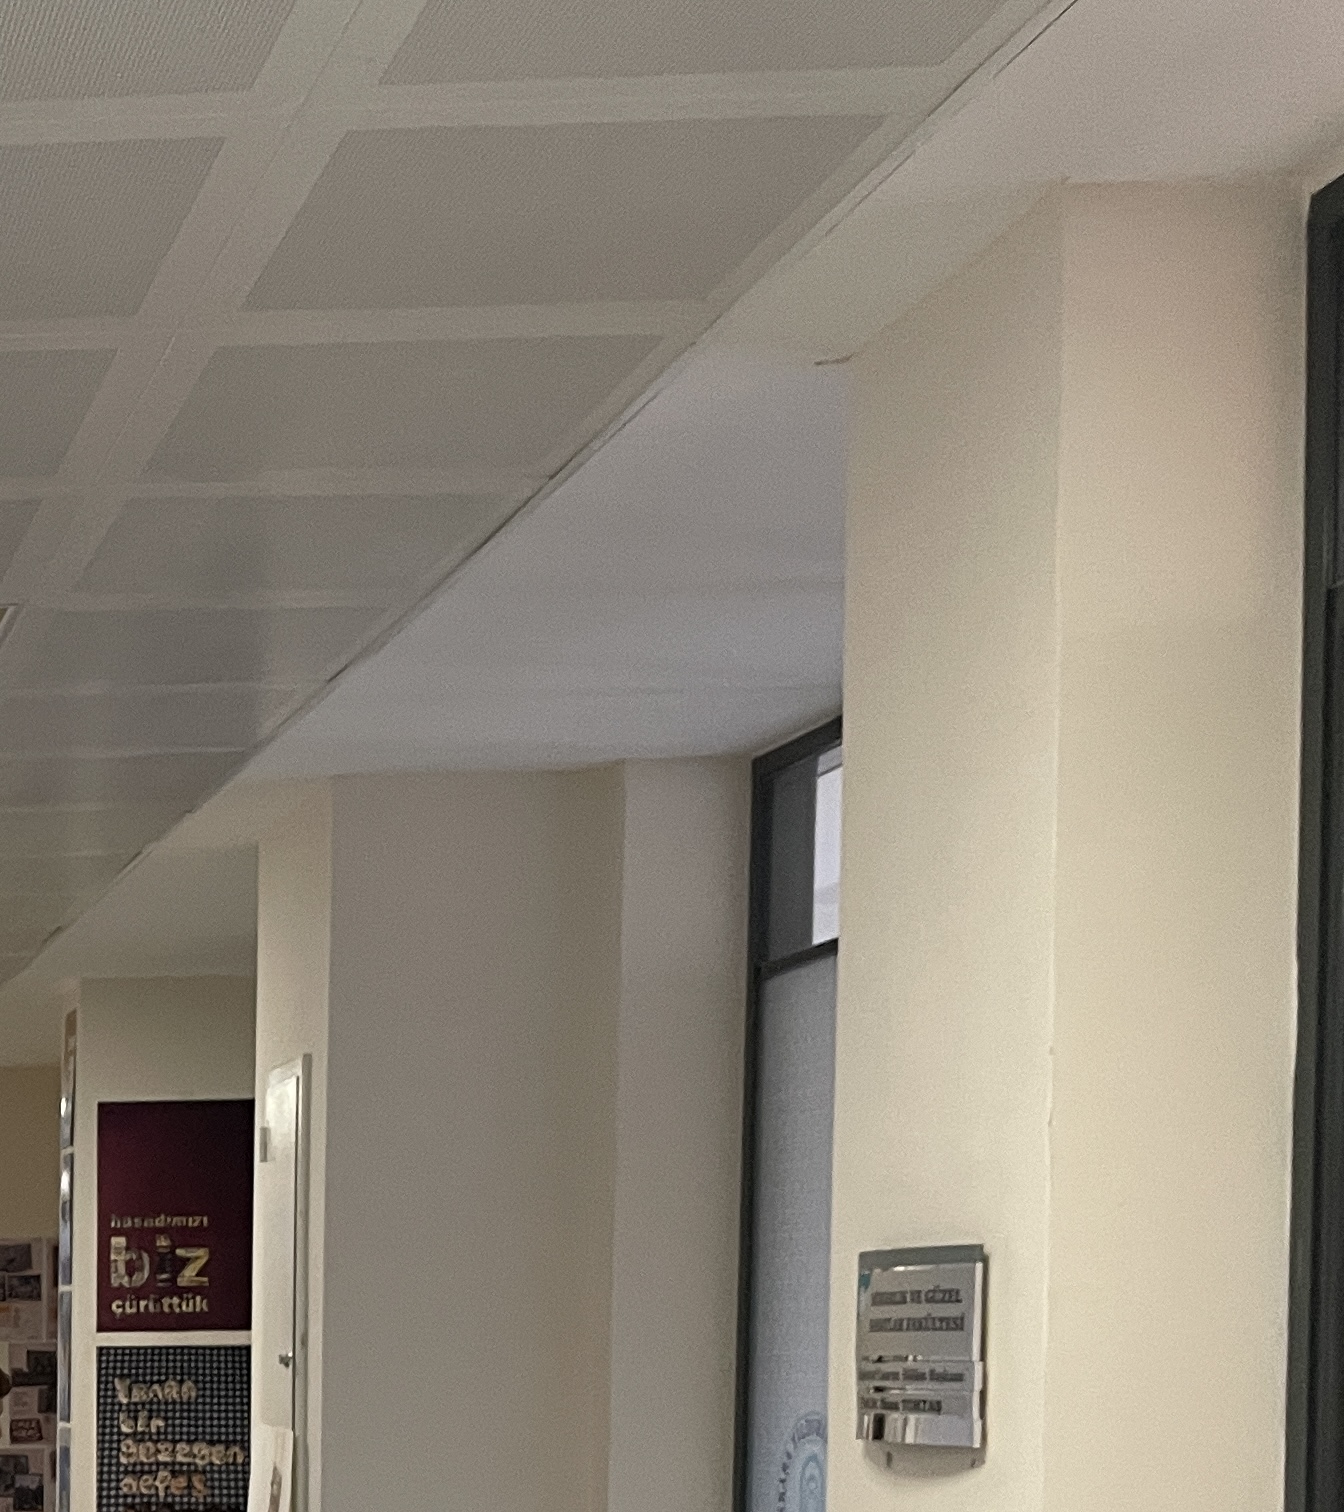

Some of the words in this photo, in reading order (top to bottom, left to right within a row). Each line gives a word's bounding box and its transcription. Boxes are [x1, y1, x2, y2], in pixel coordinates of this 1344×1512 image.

[111, 1234, 209, 1288] biz
[111, 1294, 209, 1319] çürüttük
[119, 1410, 165, 1433] bir
